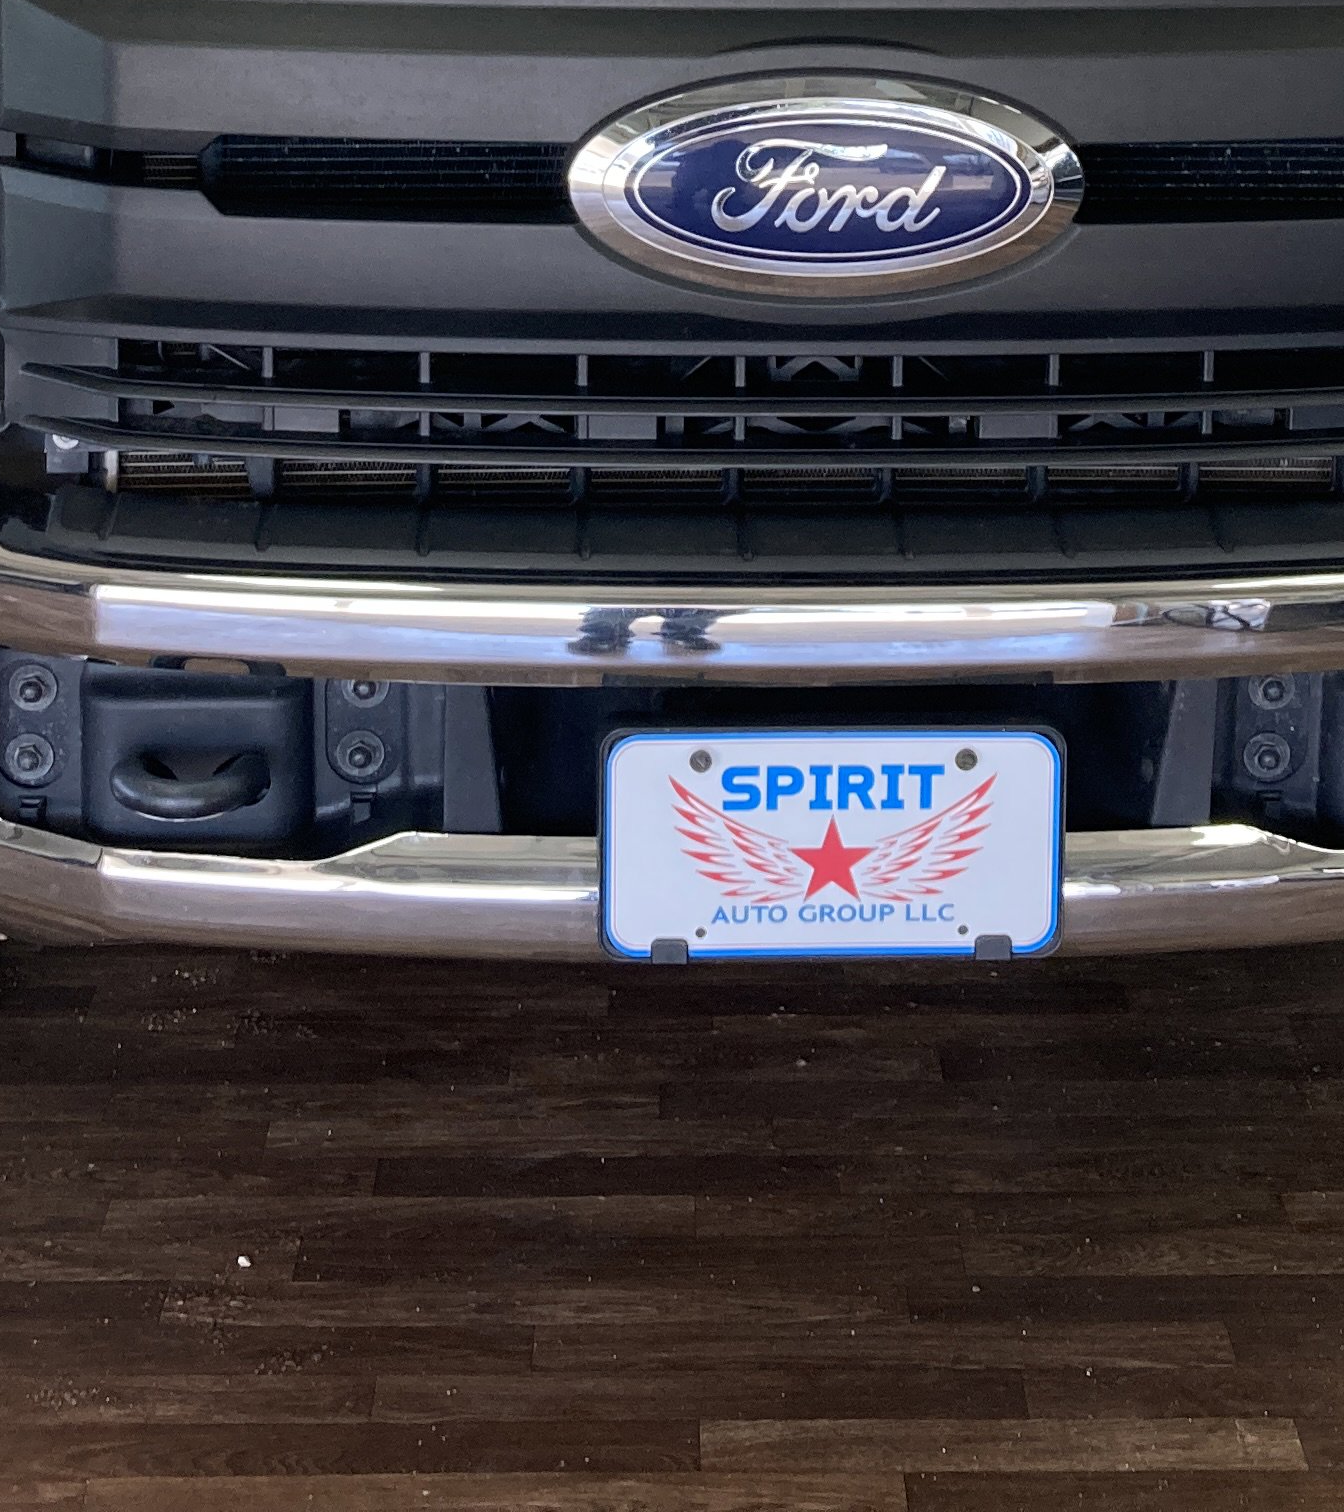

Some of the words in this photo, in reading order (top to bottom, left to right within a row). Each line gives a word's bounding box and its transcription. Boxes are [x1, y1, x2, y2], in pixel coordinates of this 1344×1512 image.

[711, 138, 947, 233] Ford
[721, 764, 946, 811] SPIRIT
[711, 905, 788, 924] AUTO
[798, 903, 896, 923] GROUP
[905, 903, 955, 922] LLC
